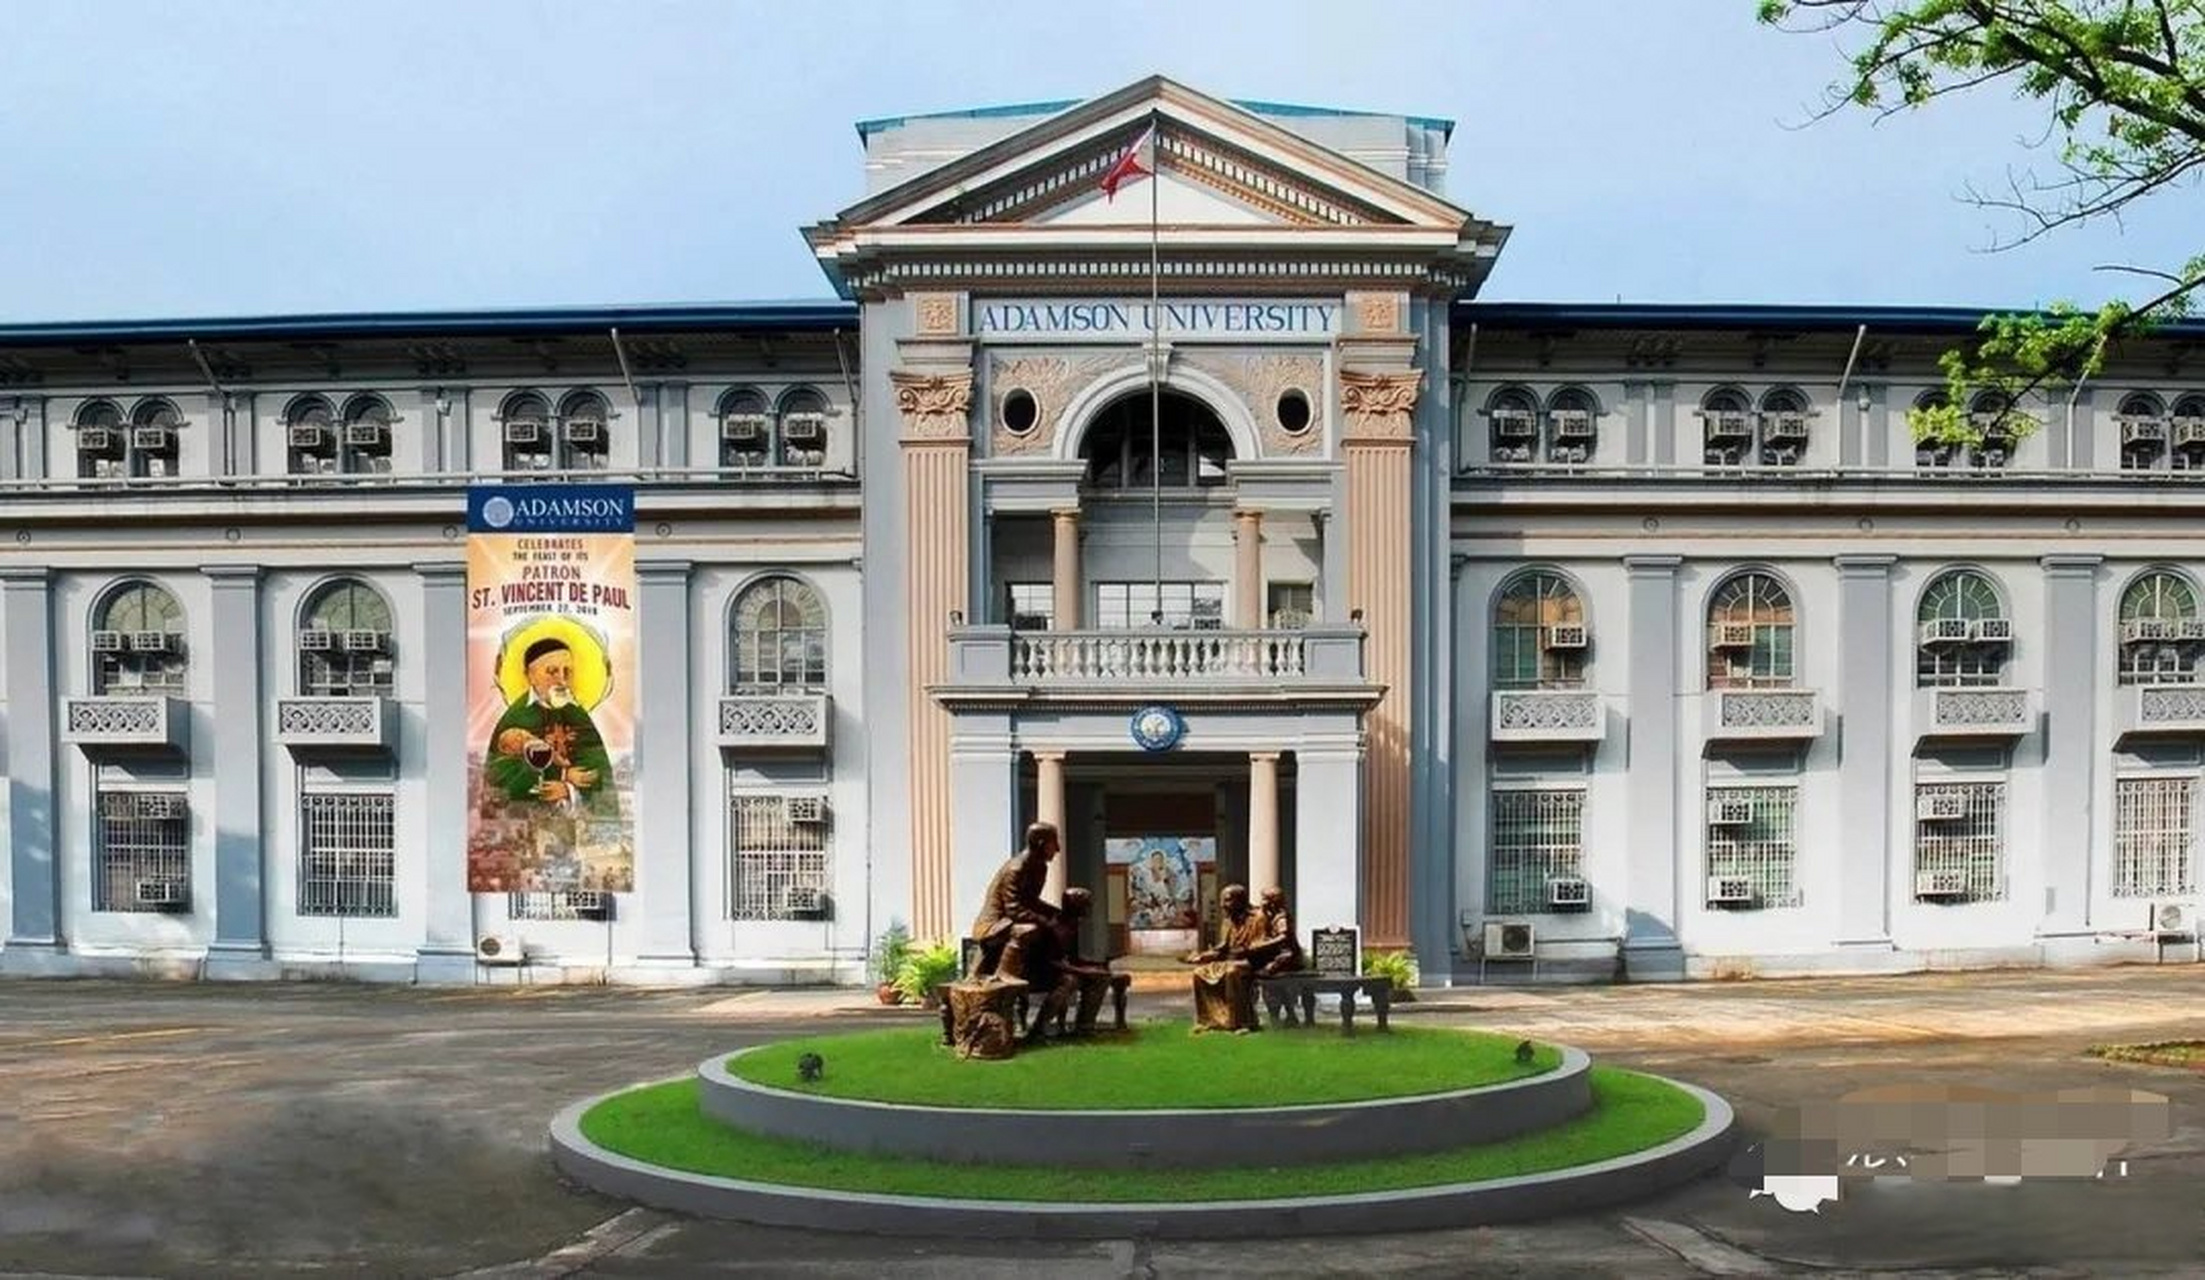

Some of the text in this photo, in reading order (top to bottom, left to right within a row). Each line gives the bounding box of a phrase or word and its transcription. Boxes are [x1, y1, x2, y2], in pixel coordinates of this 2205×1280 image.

[980, 304, 1333, 332] ADAMSON UNIVERSITY
[516, 499, 624, 517] ADAMSON
[514, 518, 624, 526] UNIVERSITY
[517, 538, 583, 549] CELEBRATES
[513, 552, 527, 561] THE
[561, 552, 571, 561] OF
[522, 565, 581, 580] PATRON
[472, 581, 631, 610] ST. VINCENT DE PAUL
[503, 604, 552, 615] SEPTEMBER
